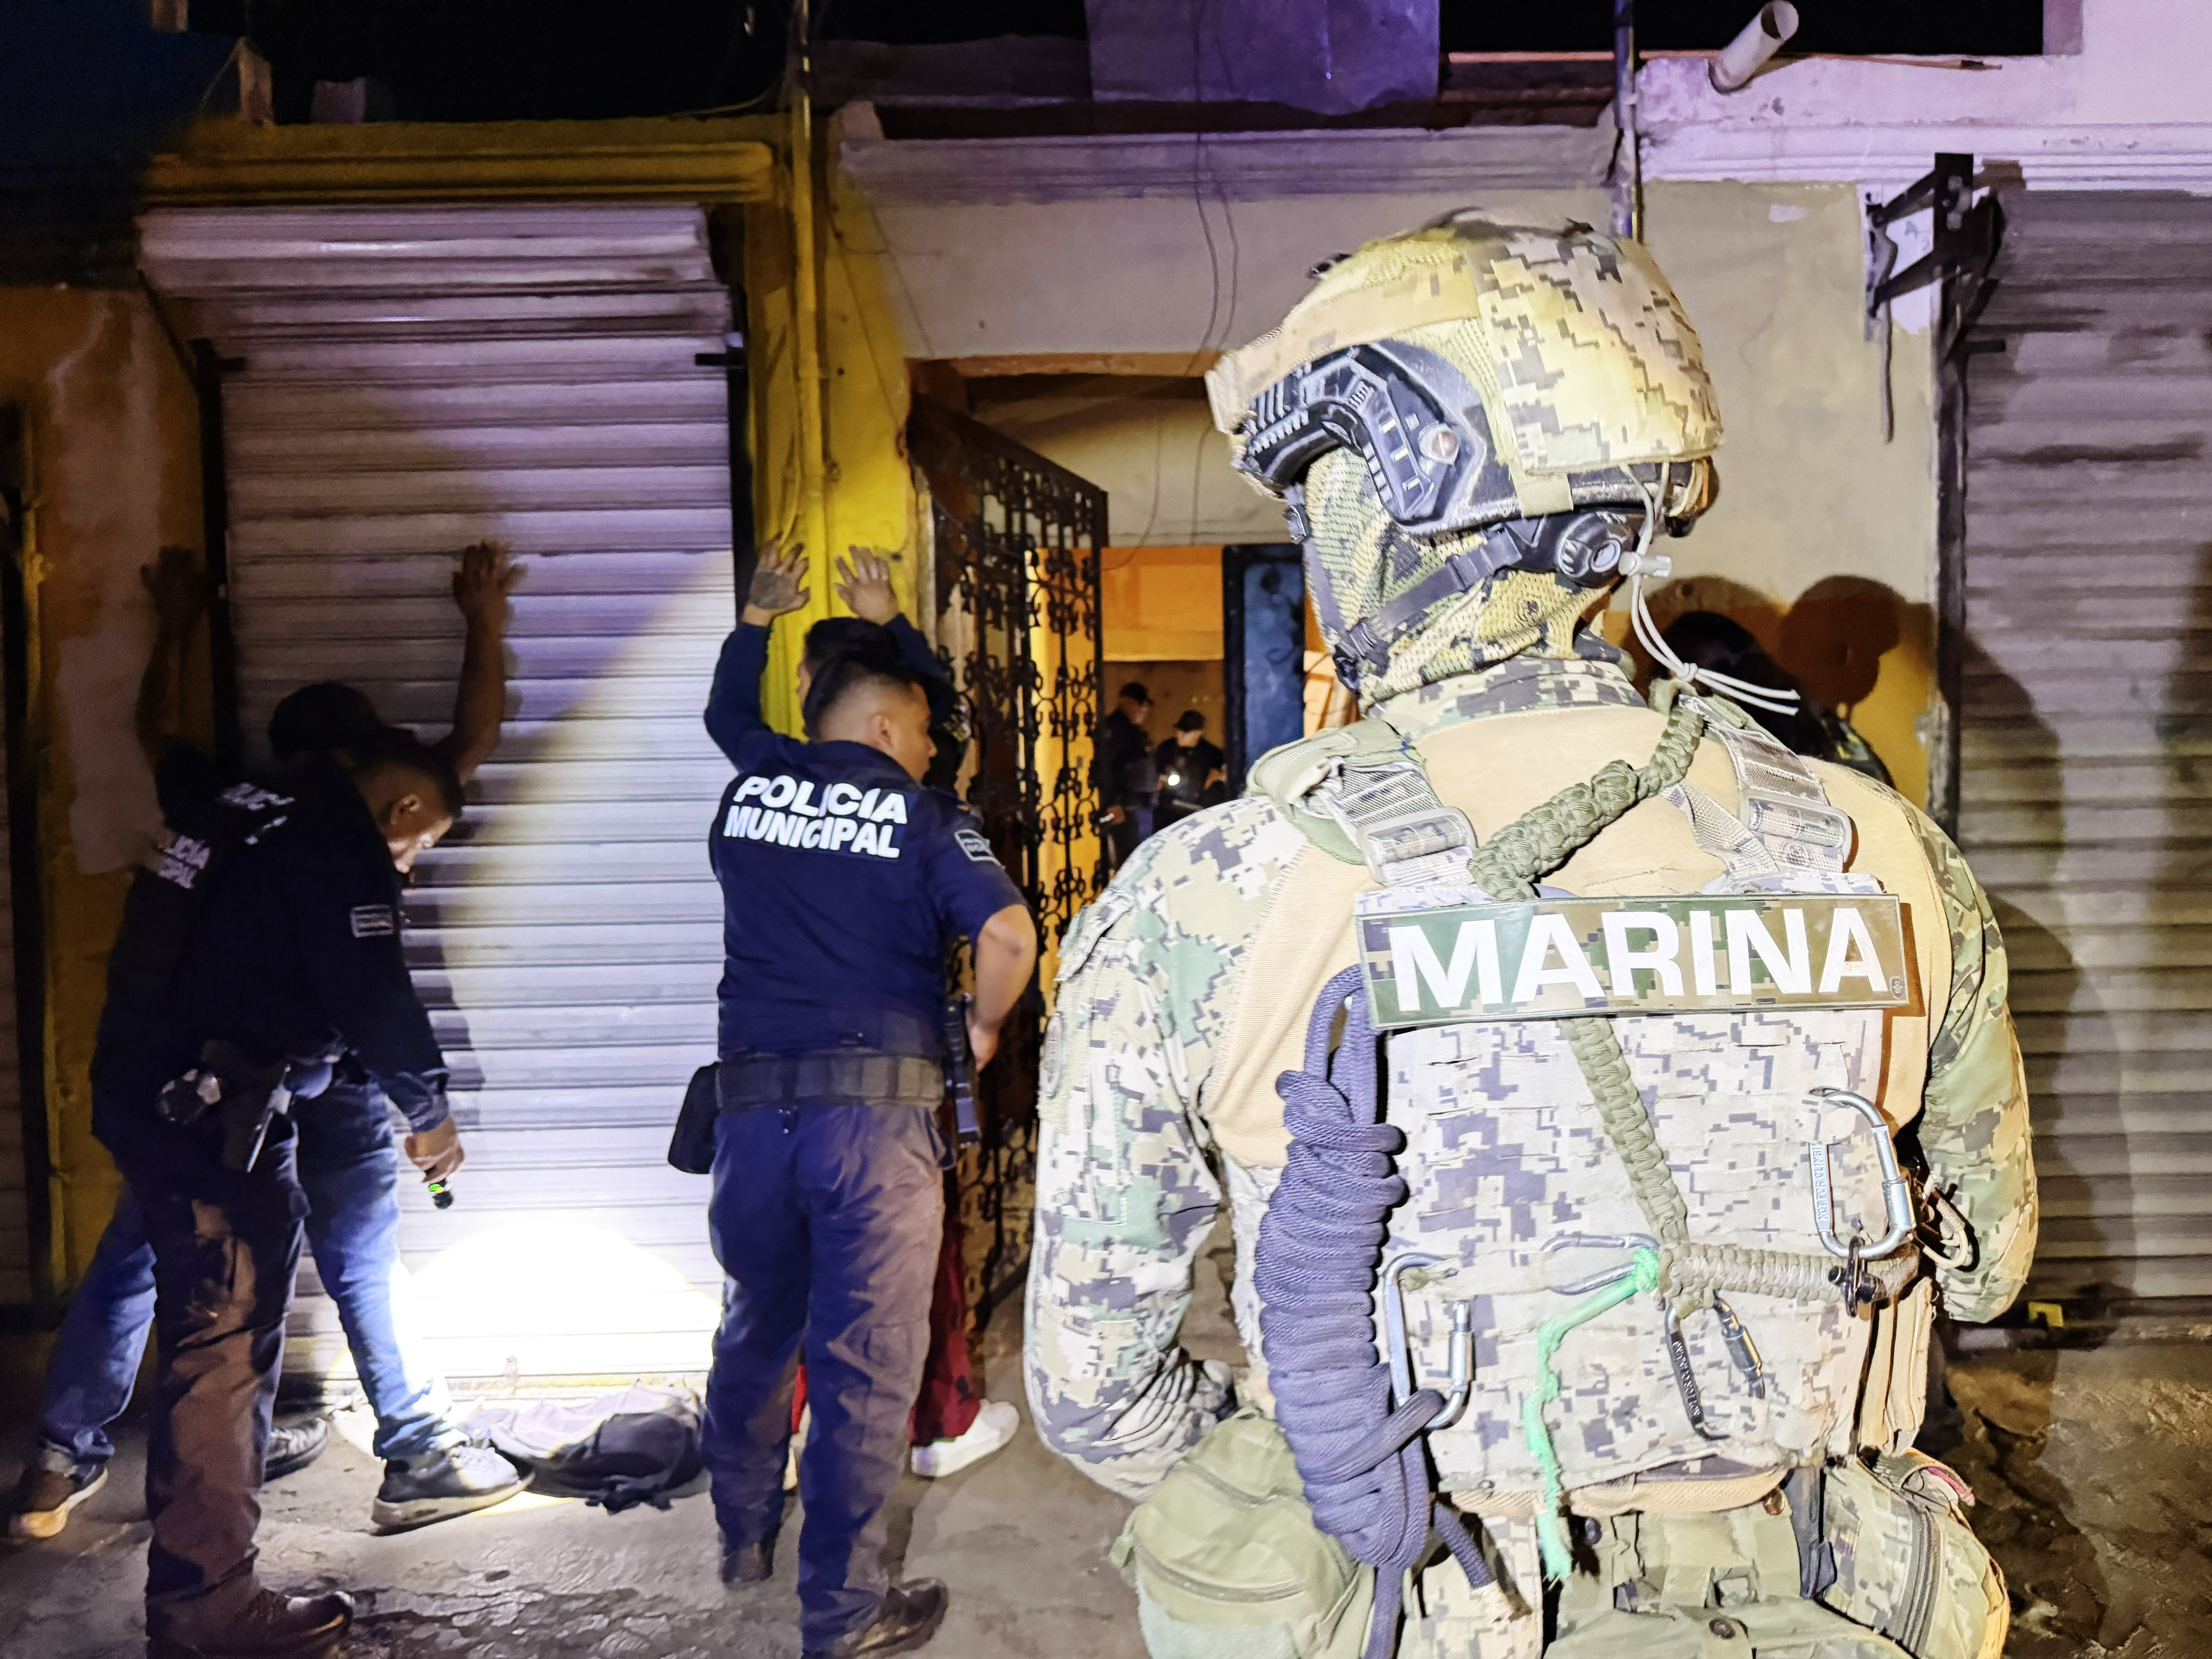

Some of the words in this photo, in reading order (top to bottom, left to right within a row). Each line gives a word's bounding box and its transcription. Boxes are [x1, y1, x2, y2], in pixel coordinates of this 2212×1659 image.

[733, 775, 907, 824] POLICIA
[724, 806, 900, 858] MUNICIPAL
[1388, 907, 1889, 1012] MARINA
[1812, 1144, 1824, 1180] CLIMBI
[1815, 1181, 1826, 1200] FOR
[1817, 1202, 1829, 1221] NOT
